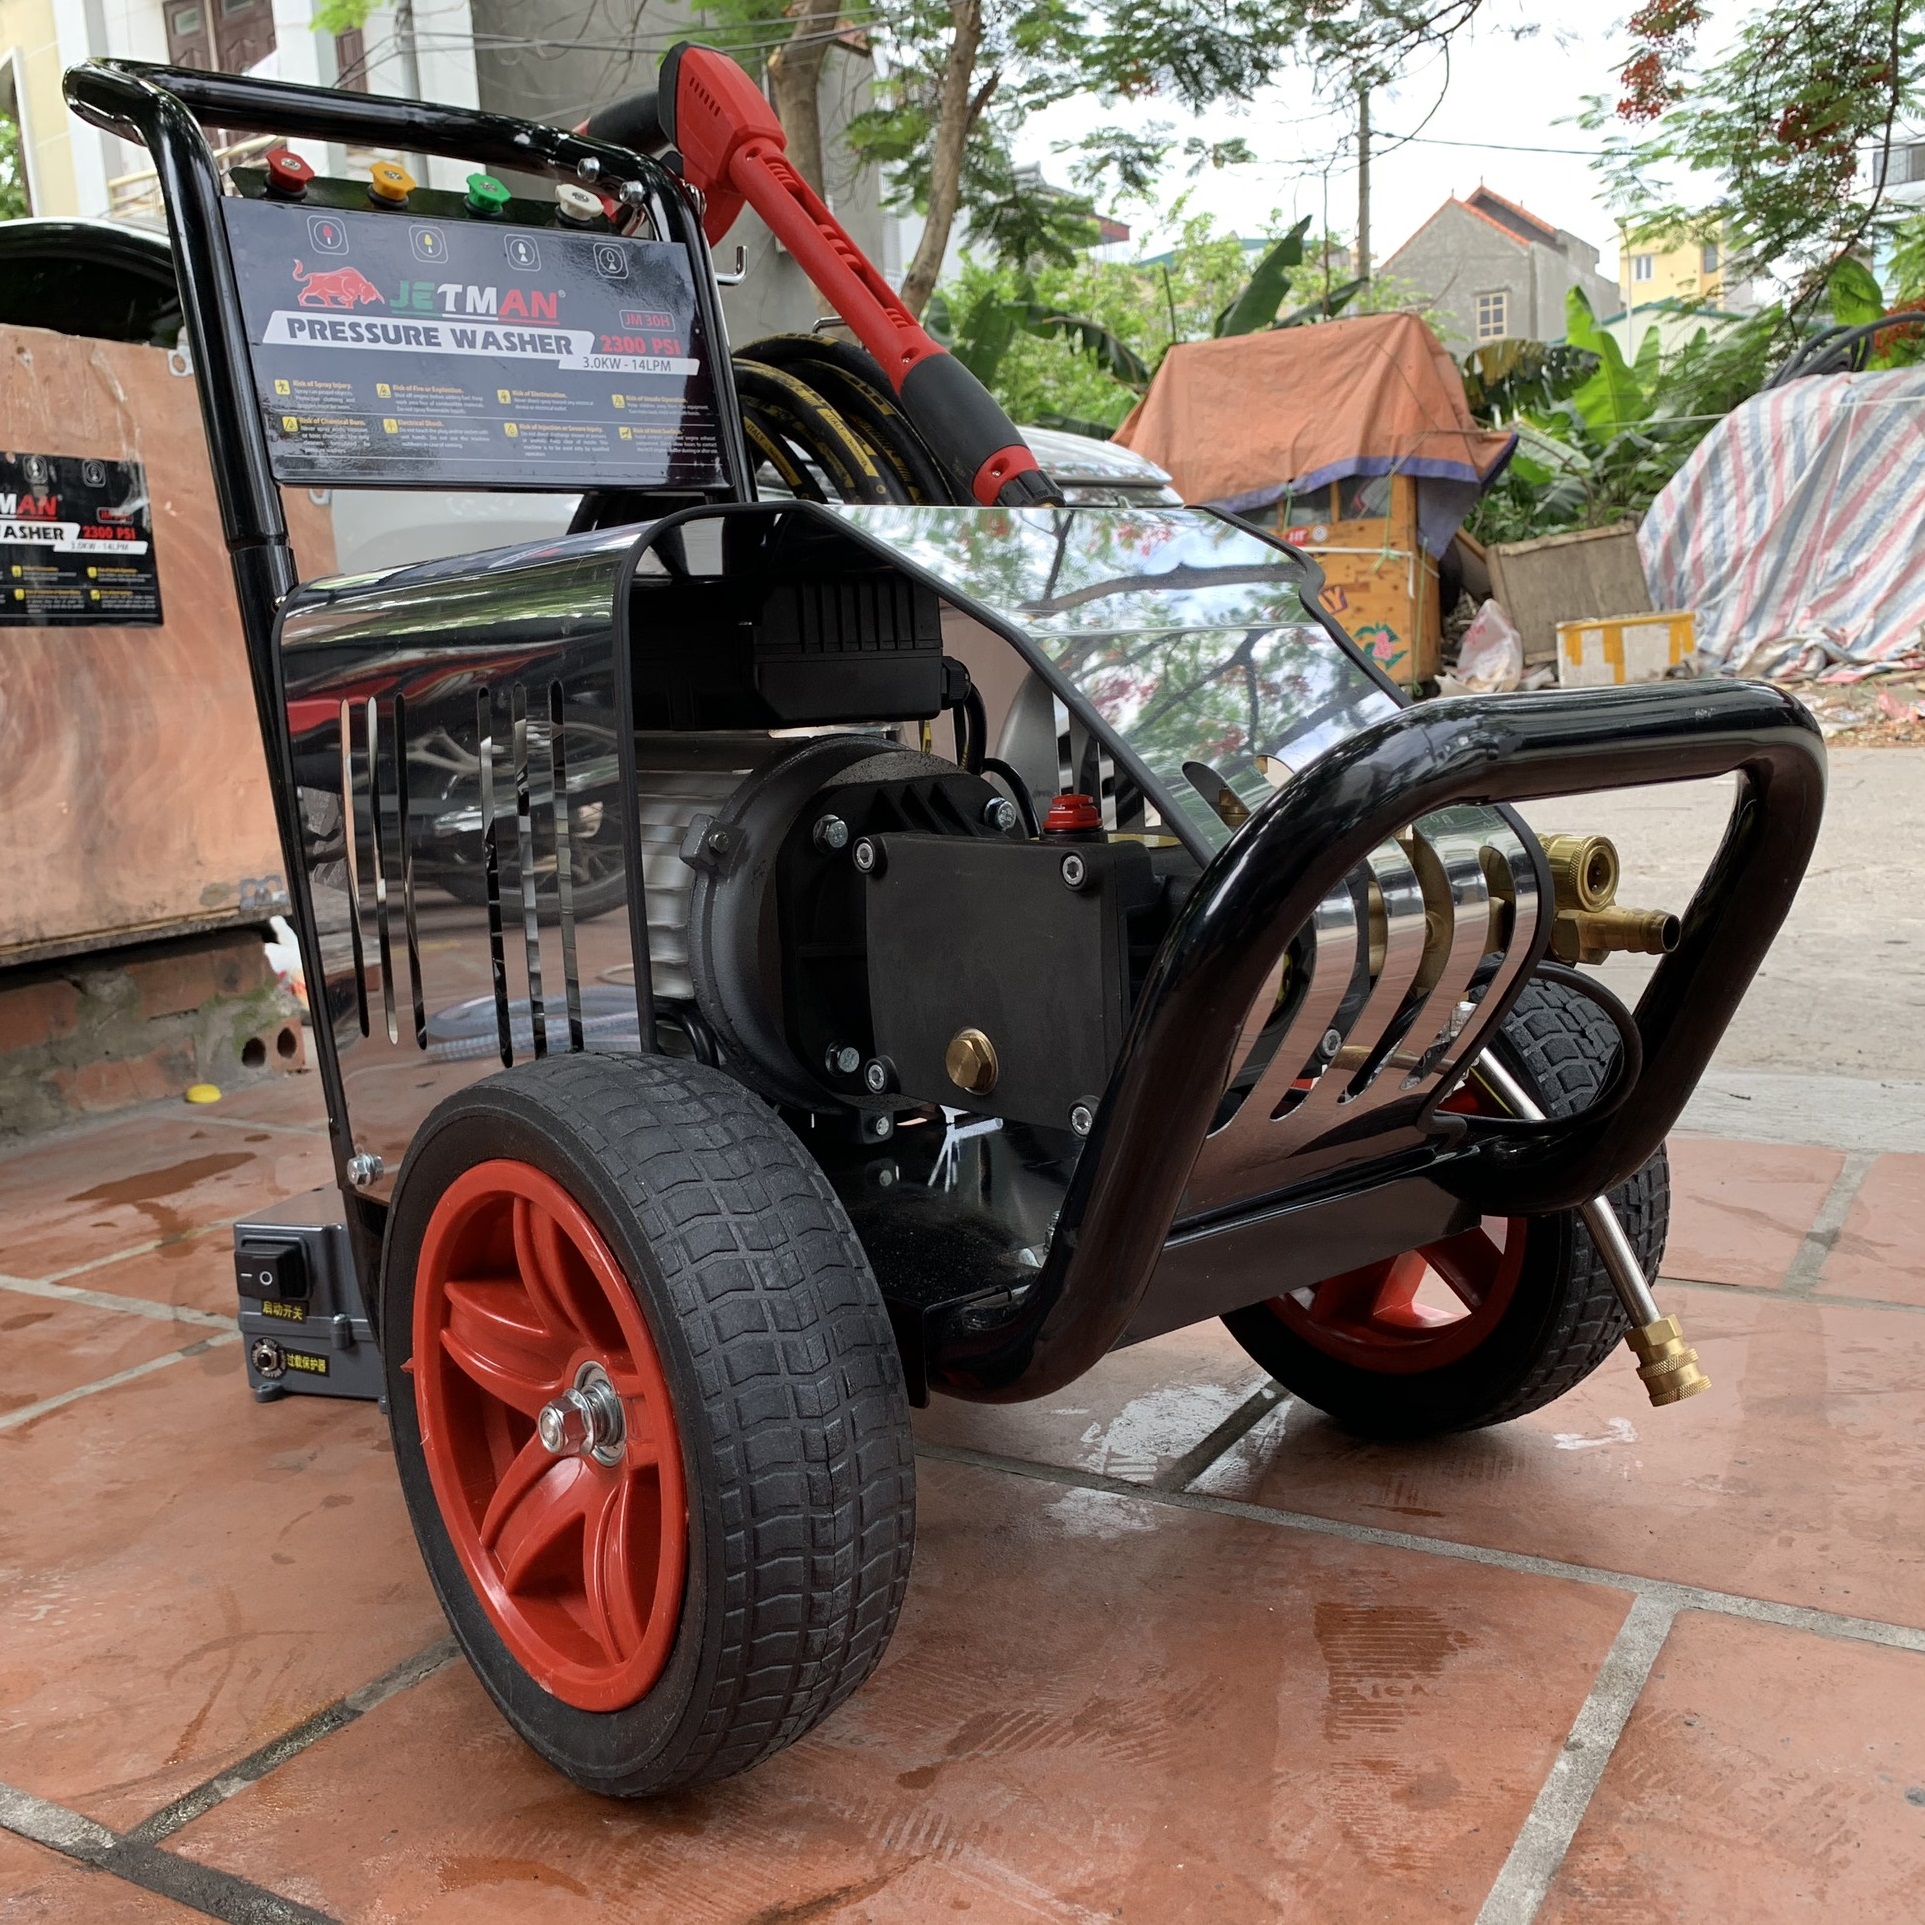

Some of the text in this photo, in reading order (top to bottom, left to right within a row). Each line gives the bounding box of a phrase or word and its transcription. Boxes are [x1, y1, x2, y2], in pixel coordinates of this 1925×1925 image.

[390, 280, 559, 319] JETMAN
[625, 315, 671, 327] JM 30H
[287, 318, 574, 355] PRESSURE WASHER
[600, 334, 682, 355] 2300 PSI
[583, 356, 621, 370] 3.0KW
[631, 358, 672, 372] 14LPM
[4, 526, 65, 540] ASHER
[82, 525, 136, 540] 2300 PSI
[263, 1300, 303, 1321] 启动开关
